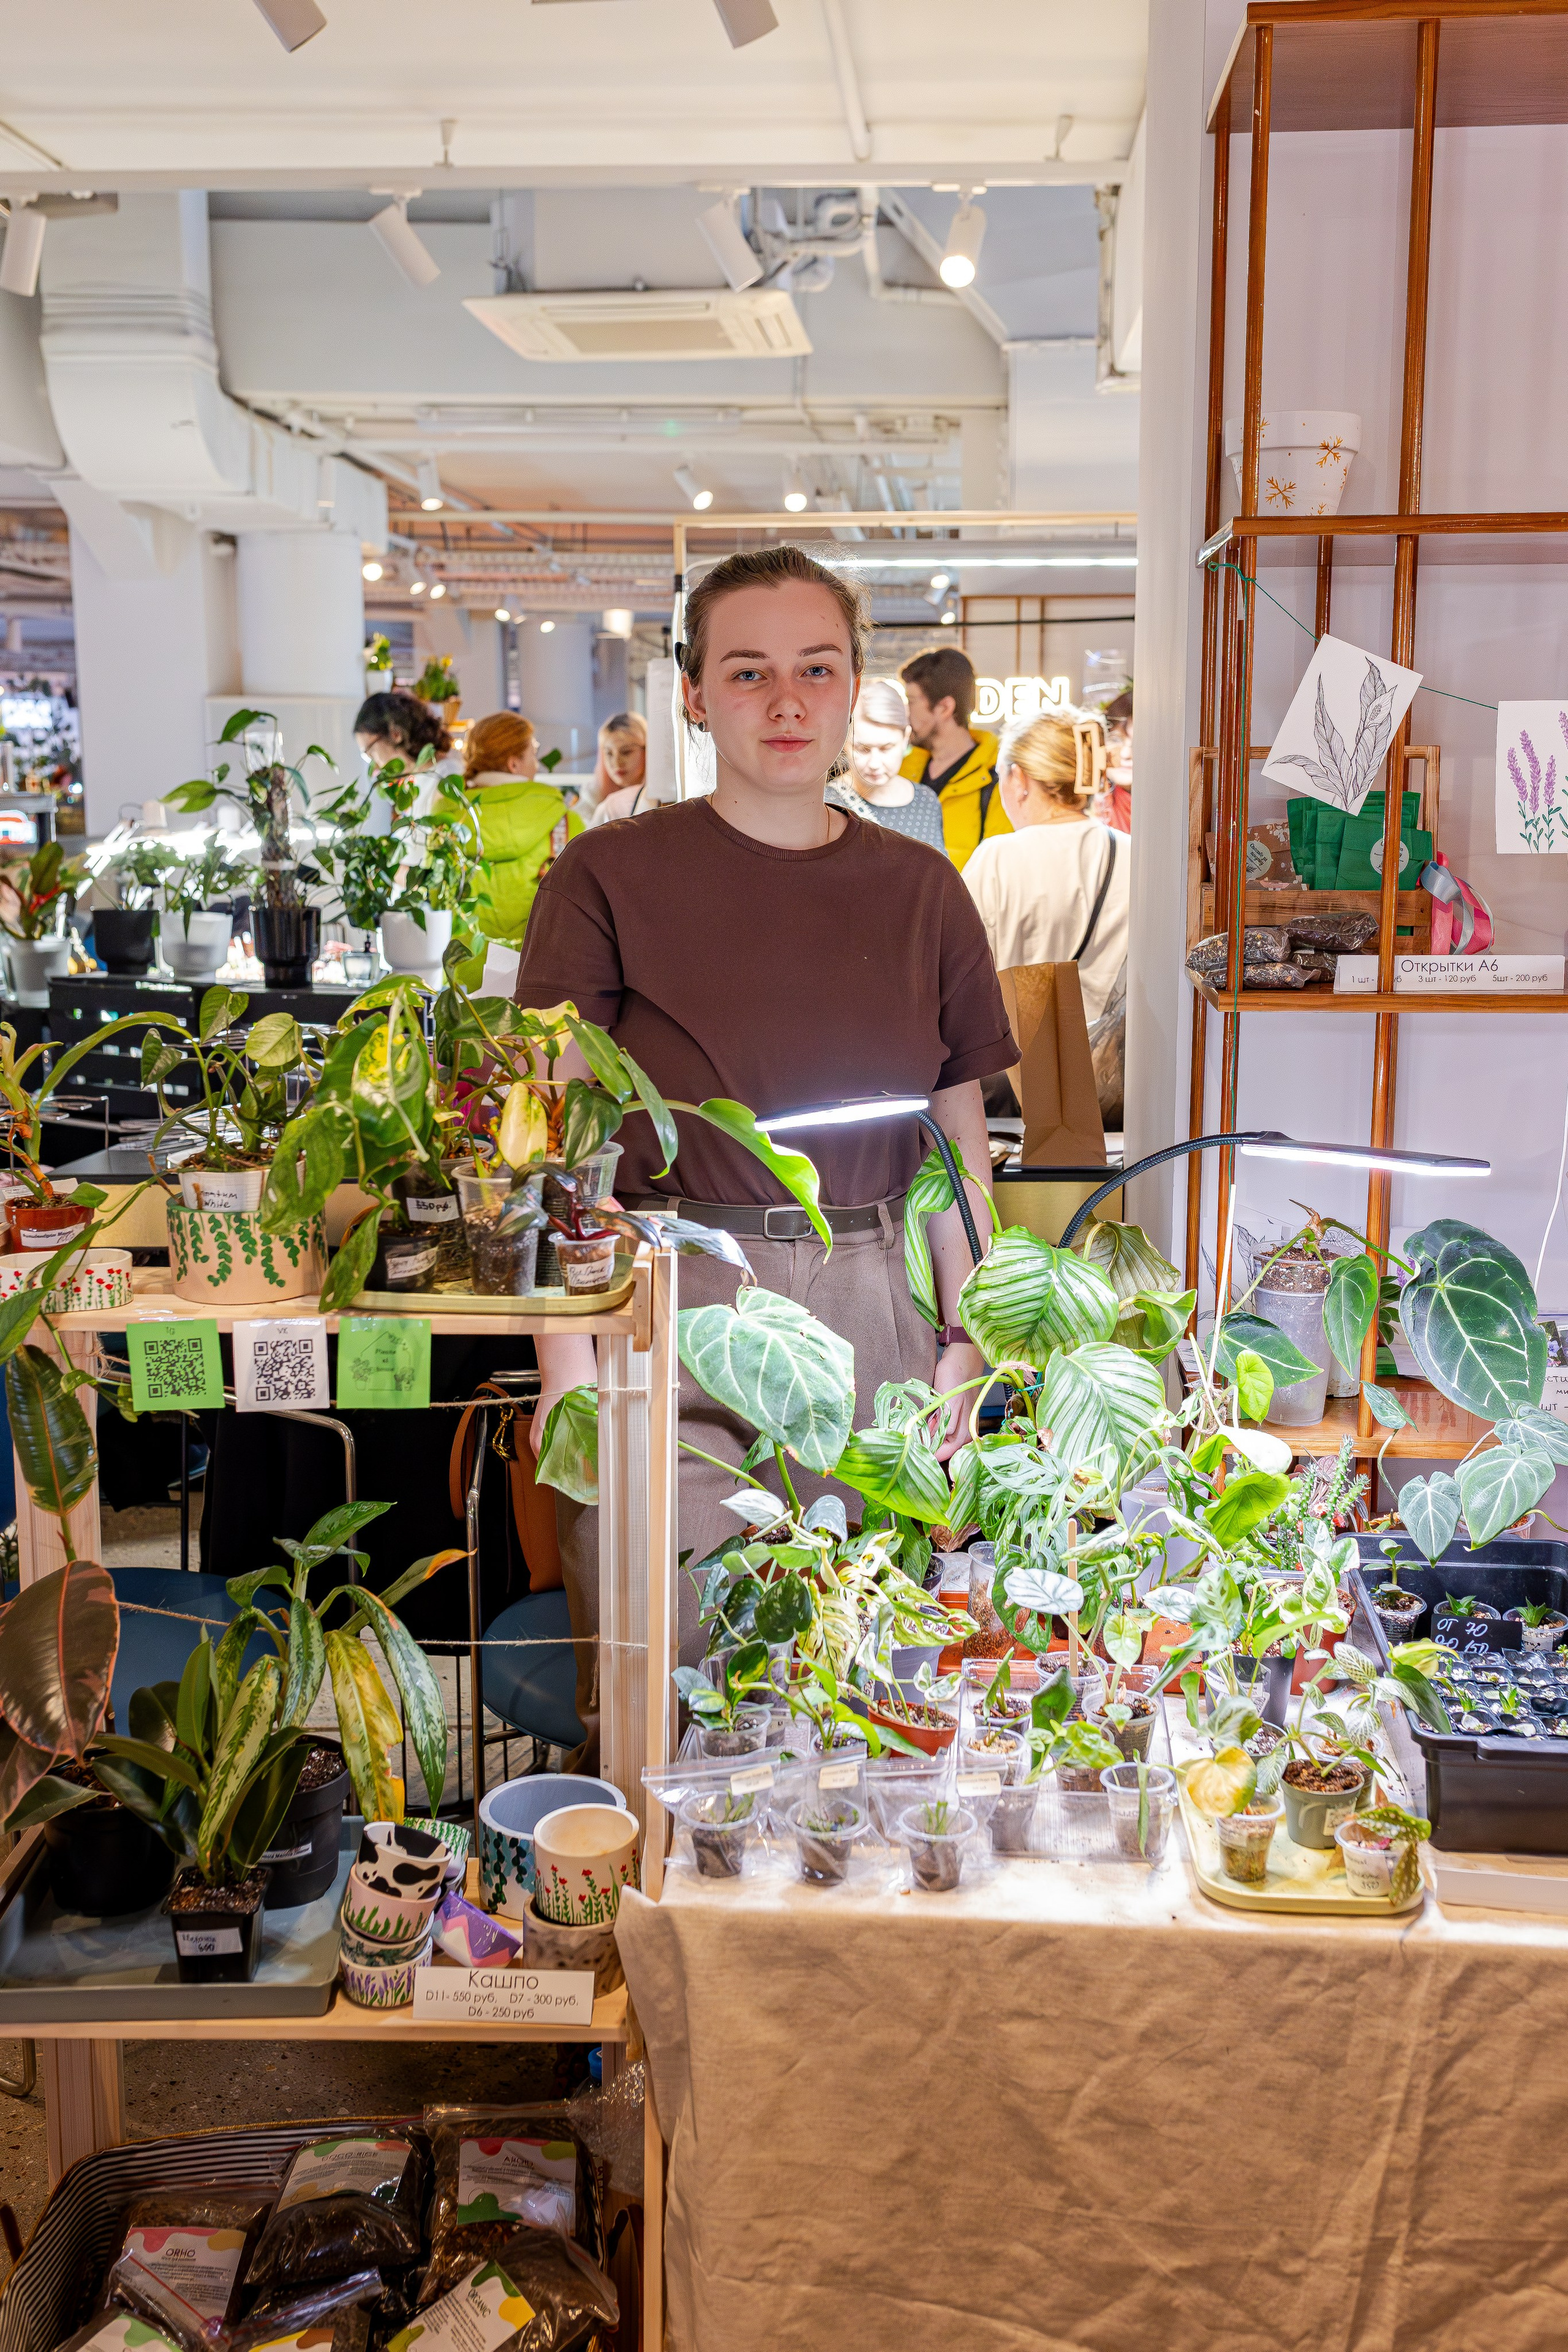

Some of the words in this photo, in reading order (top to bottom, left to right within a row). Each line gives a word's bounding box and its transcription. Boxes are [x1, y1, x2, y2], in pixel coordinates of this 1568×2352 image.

[1401, 959, 1474, 976] Открытки
[1478, 959, 1499, 971] А6
[1460, 974, 1477, 984] руб
[1532, 974, 1548, 984] руб
[1464, 1621, 1488, 1637] 70
[469, 1970, 539, 1990] Кашпо
[453, 1991, 471, 2002] 550
[510, 1993, 524, 2003] D7
[533, 1994, 552, 2005] 300
[469, 2006, 483, 2017] D6
[492, 2007, 510, 2018] 250
[513, 2008, 534, 2021] руб
